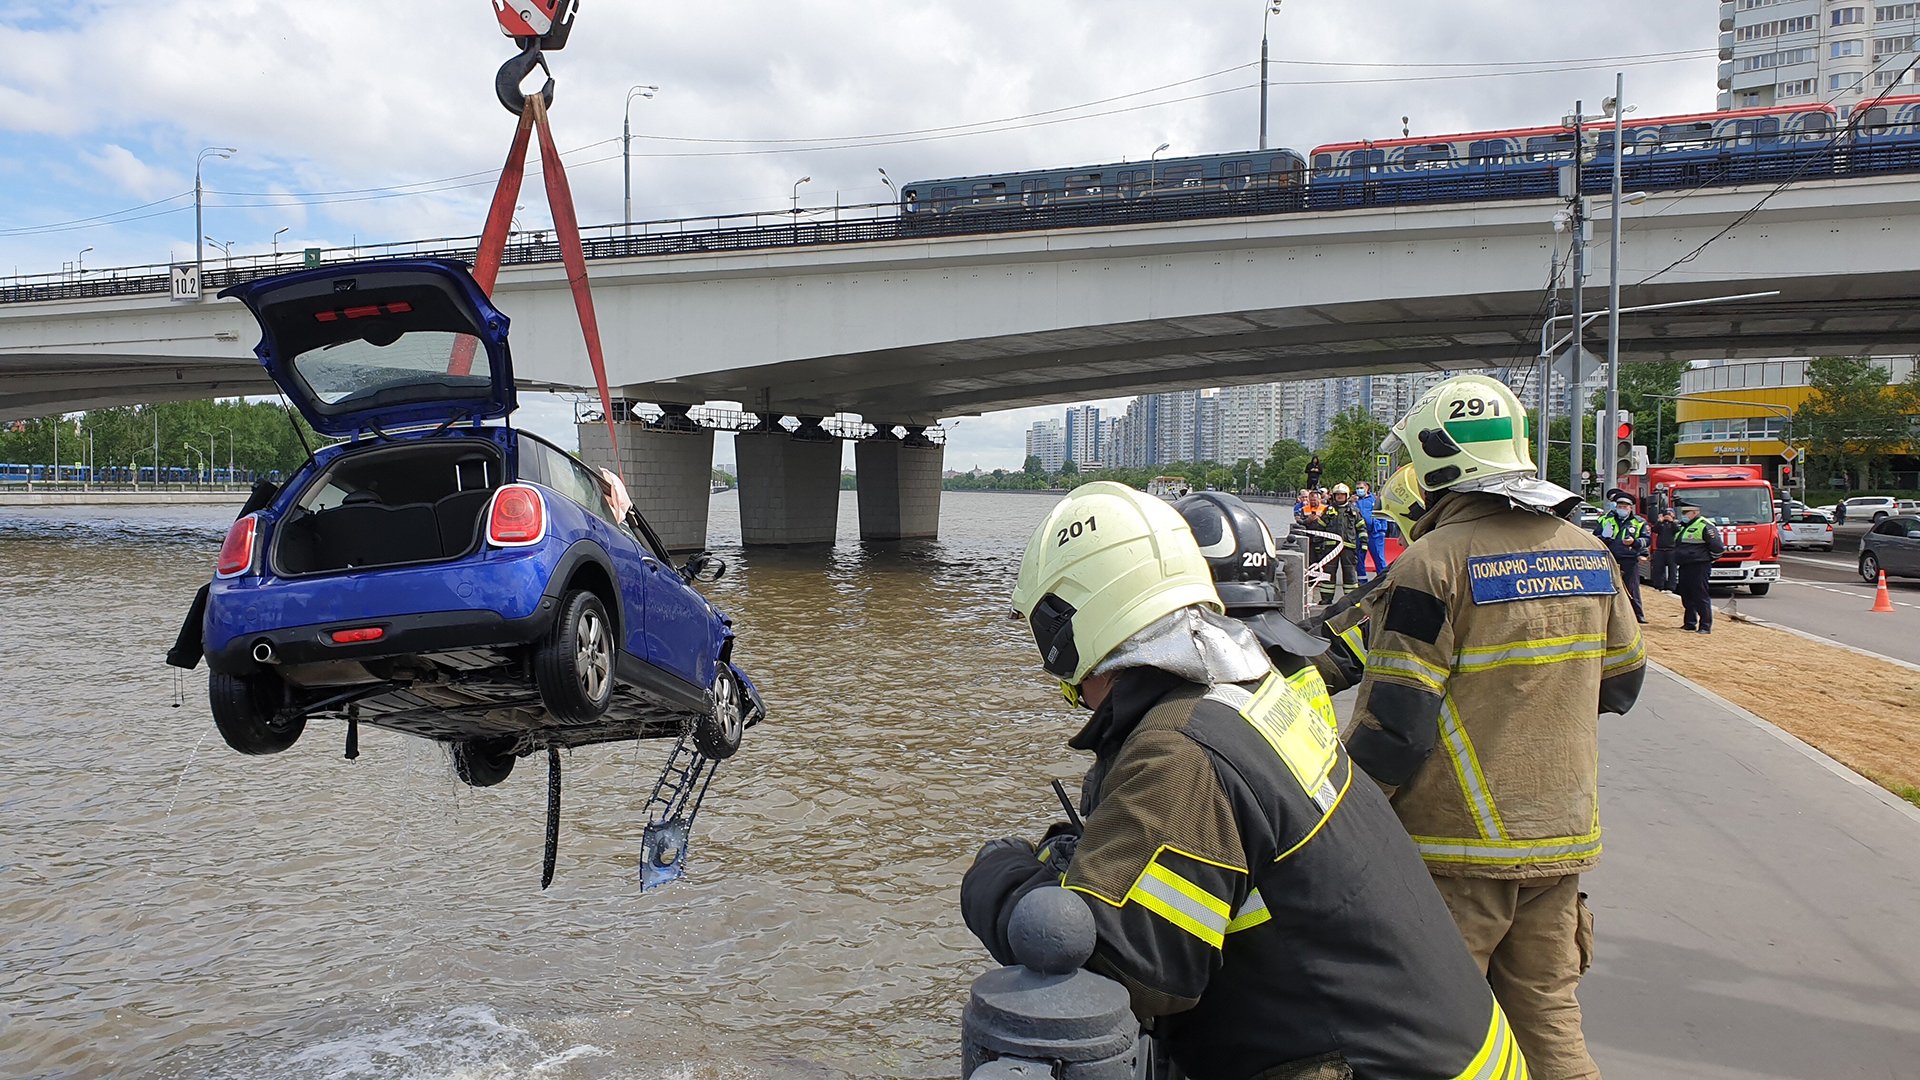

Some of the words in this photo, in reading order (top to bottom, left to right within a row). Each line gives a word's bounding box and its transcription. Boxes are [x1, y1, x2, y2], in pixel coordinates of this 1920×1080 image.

[175, 277, 197, 295] 10.2
[1448, 398, 1500, 419] 291
[1056, 515, 1097, 547] 201
[1242, 551, 1267, 567] 201
[1515, 575, 1585, 595] СЛУЖБА
